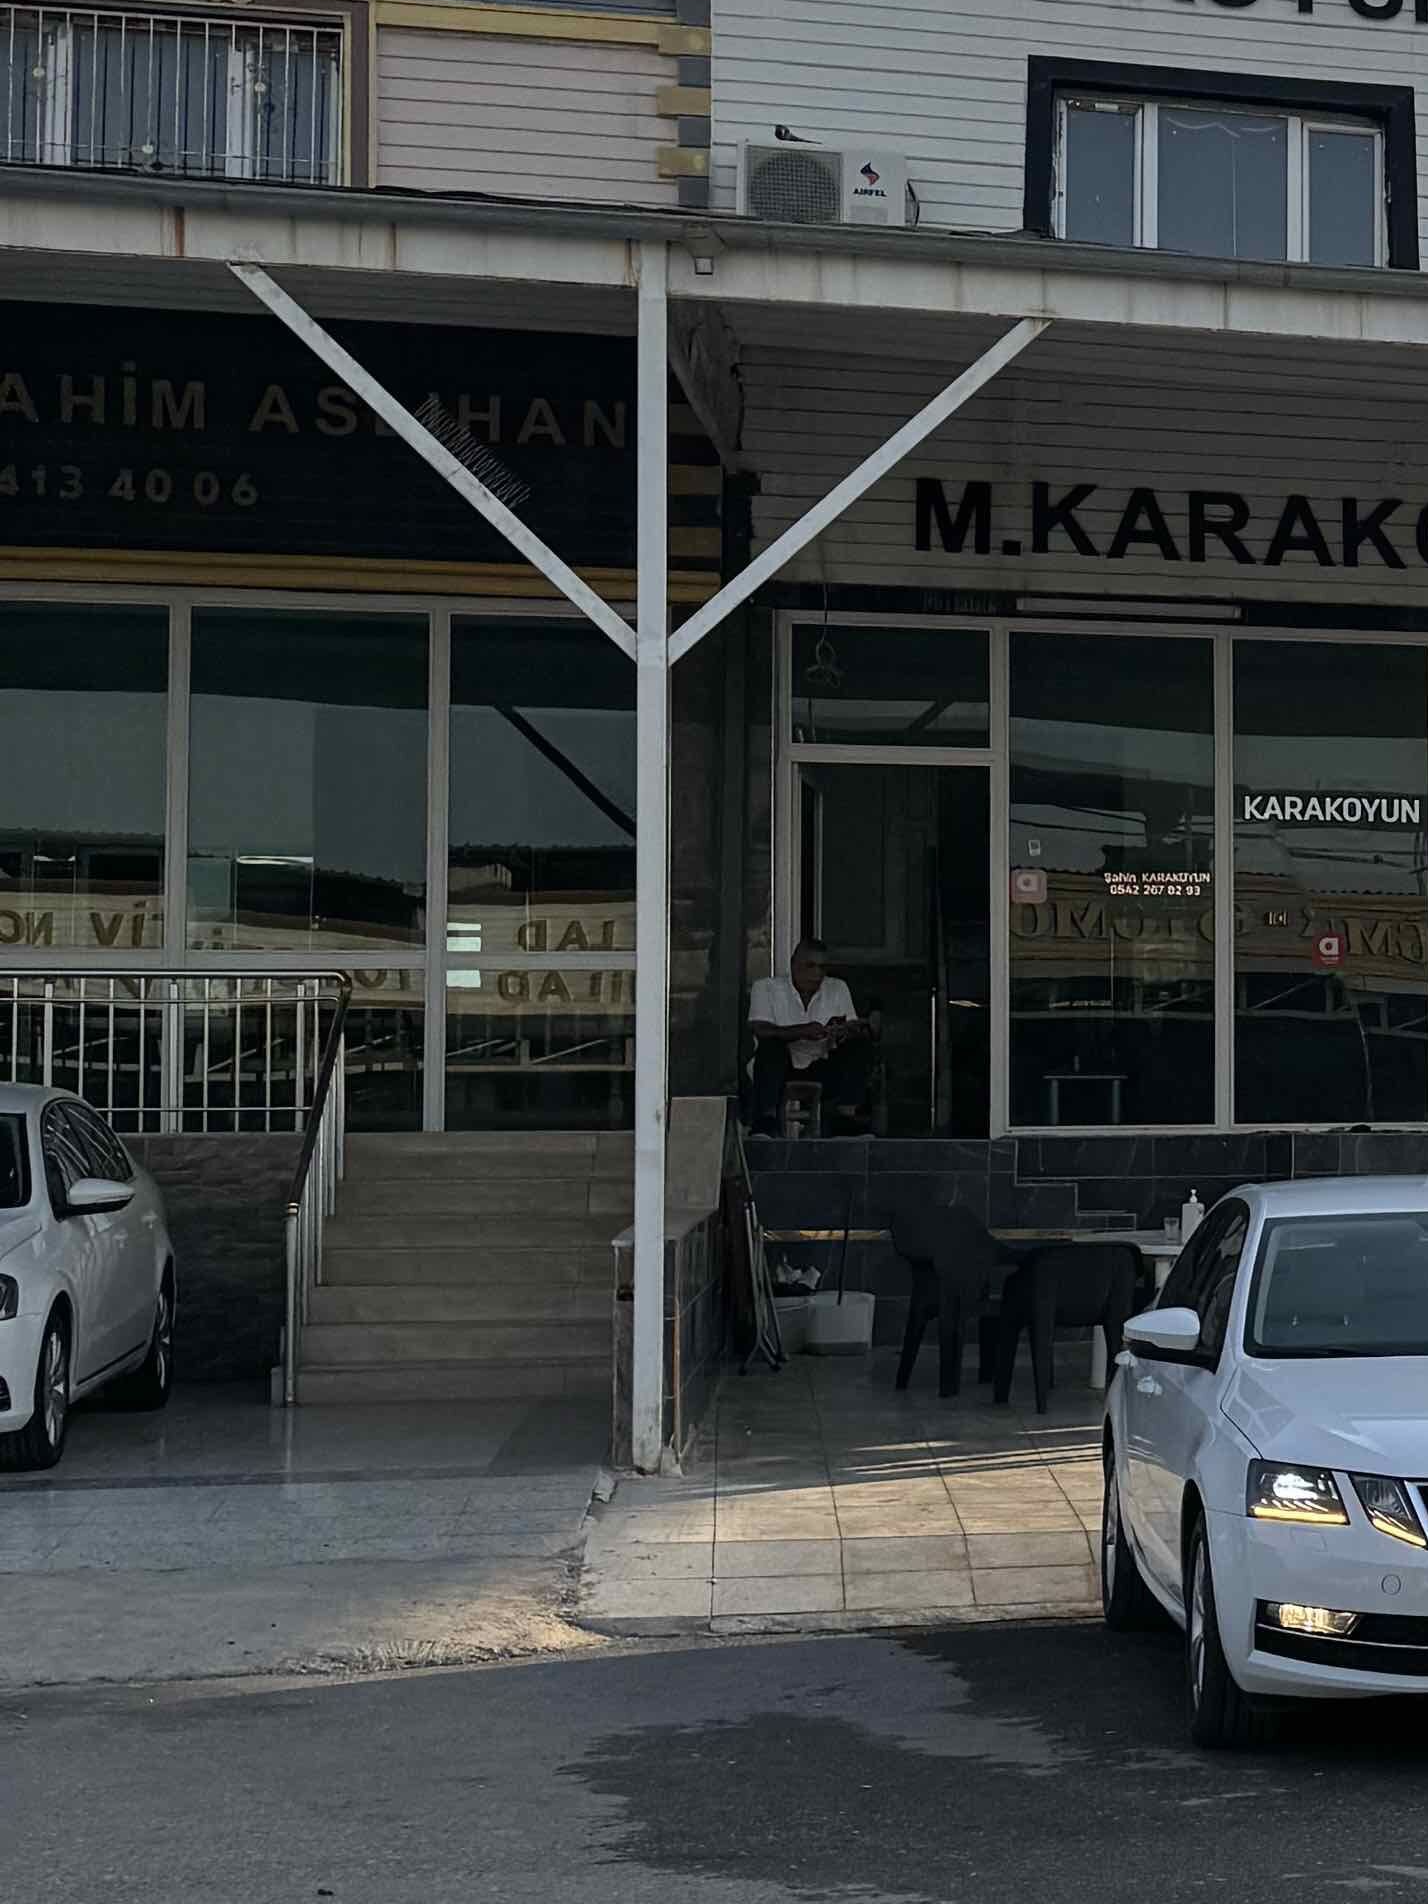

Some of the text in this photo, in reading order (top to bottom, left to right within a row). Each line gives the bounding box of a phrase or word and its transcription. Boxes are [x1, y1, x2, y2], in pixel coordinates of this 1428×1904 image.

[249, 382, 628, 449] ASLHAN
[109, 468, 172, 504] 40
[192, 470, 260, 507] 06
[1244, 796, 1420, 825] KARAKOYUN
